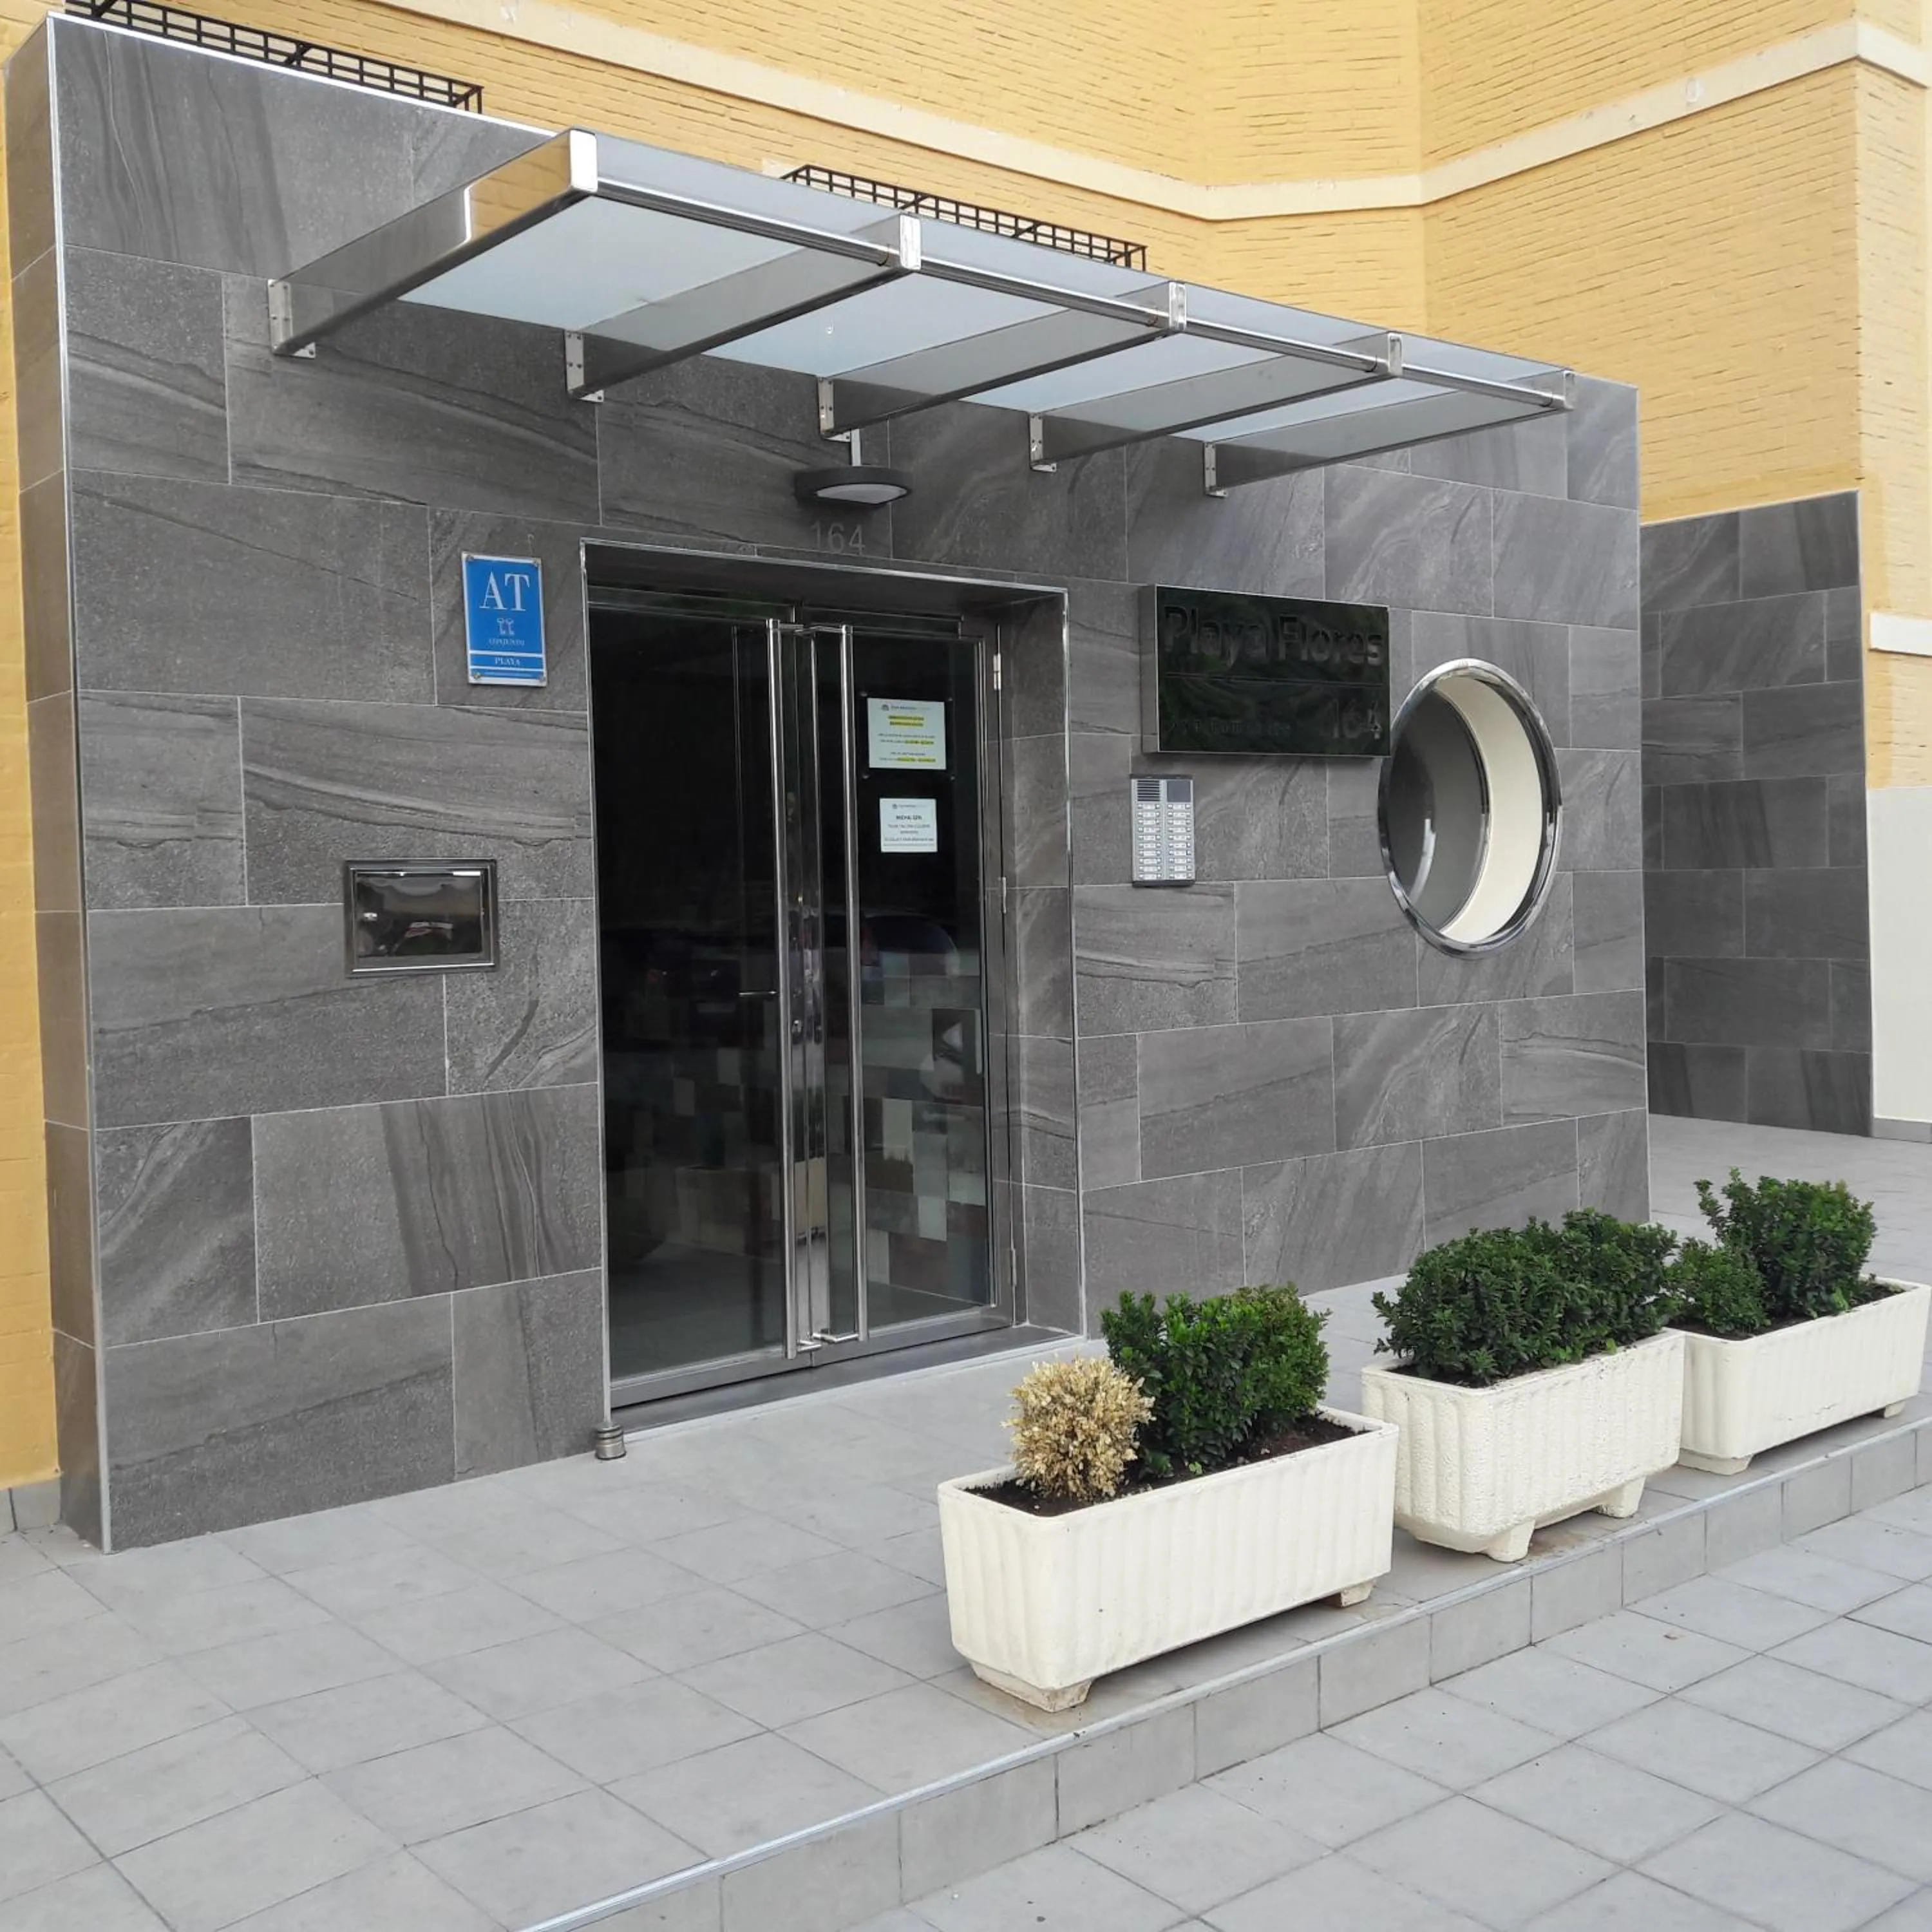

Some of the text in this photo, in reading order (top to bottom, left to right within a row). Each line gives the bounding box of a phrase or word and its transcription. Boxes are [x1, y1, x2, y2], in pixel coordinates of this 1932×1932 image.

[811, 520, 866, 555] 164
[478, 571, 530, 611] AT
[1163, 605, 1385, 668] Playa Flores
[494, 656, 521, 667] PLAYA
[1331, 698, 1382, 740] 164
